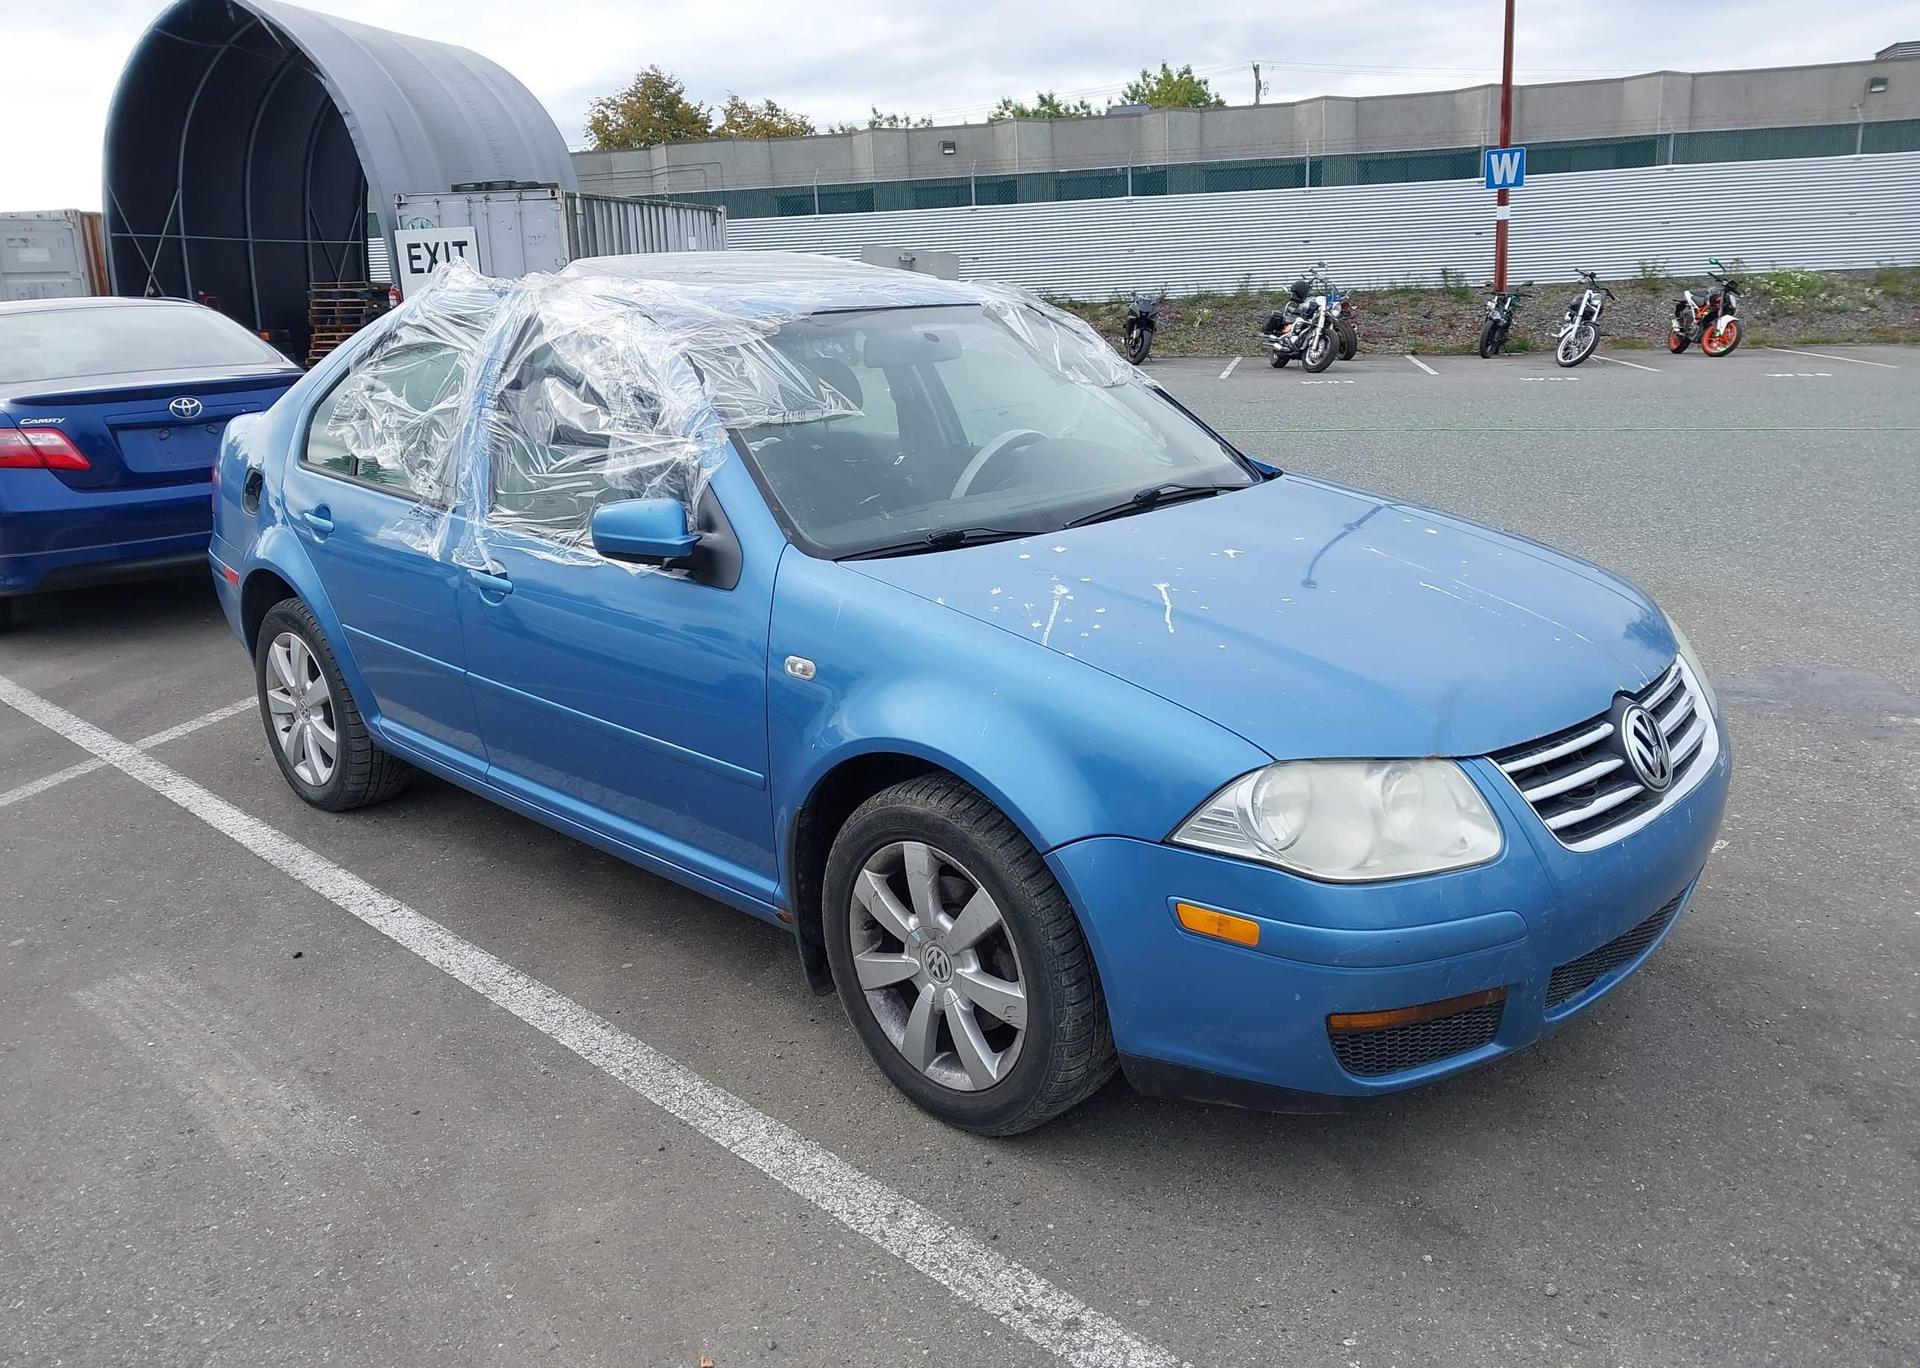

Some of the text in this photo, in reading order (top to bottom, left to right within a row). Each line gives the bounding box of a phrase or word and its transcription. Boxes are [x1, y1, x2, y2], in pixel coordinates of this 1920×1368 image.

[1491, 152, 1520, 184] W
[406, 240, 468, 274] EXIT
[20, 417, 66, 425] CAMRY
